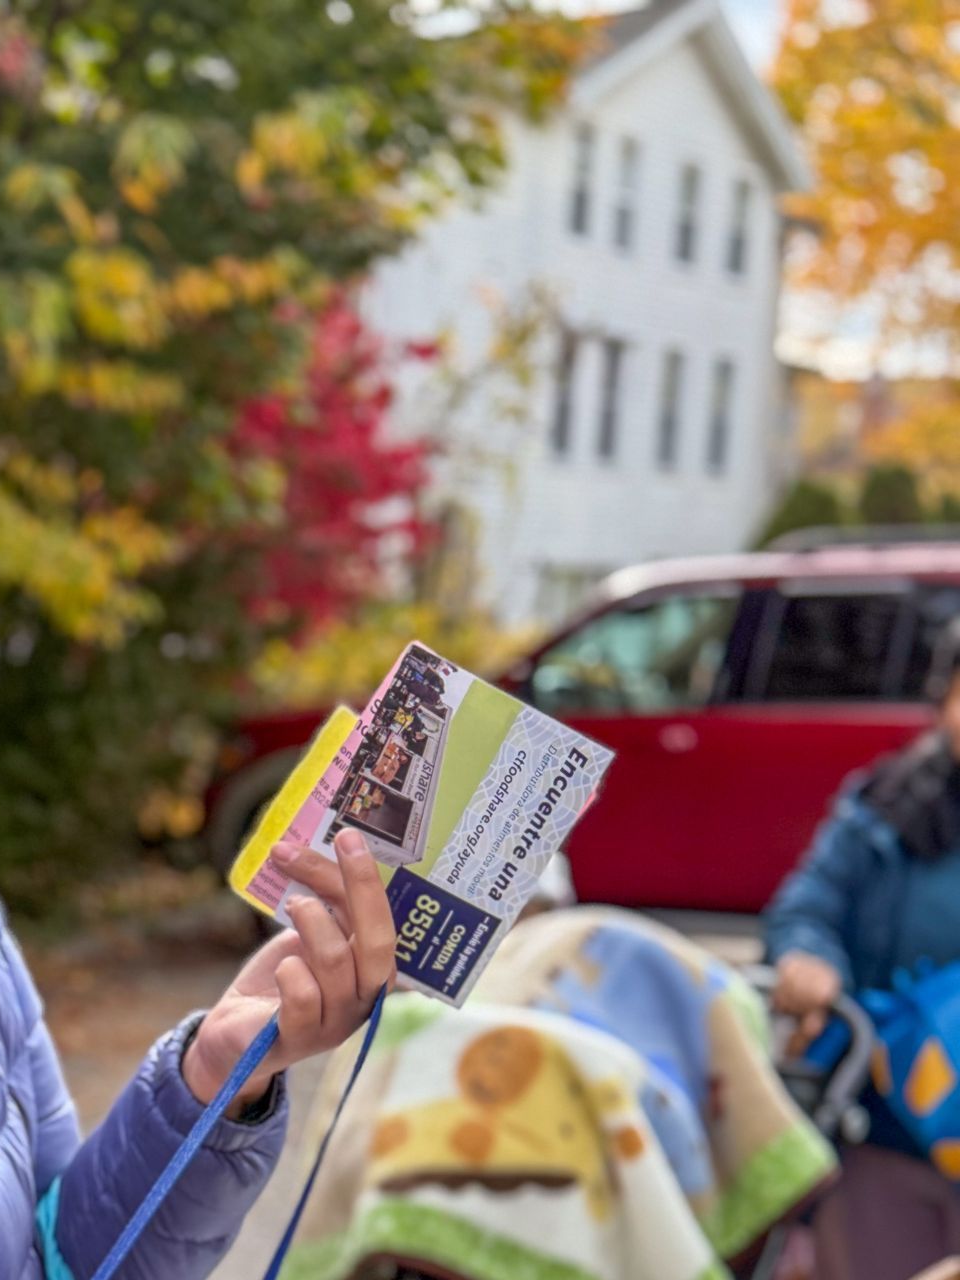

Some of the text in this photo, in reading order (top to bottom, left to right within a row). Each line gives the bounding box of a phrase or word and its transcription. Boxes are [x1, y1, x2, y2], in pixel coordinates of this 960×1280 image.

[447, 750, 526, 884] ctfoodshare.org/ayuda
[488, 747, 588, 901] Encuentre una
[510, 809, 520, 821] de
[395, 894, 440, 962] 85511
[432, 925, 466, 971] COMIDA
